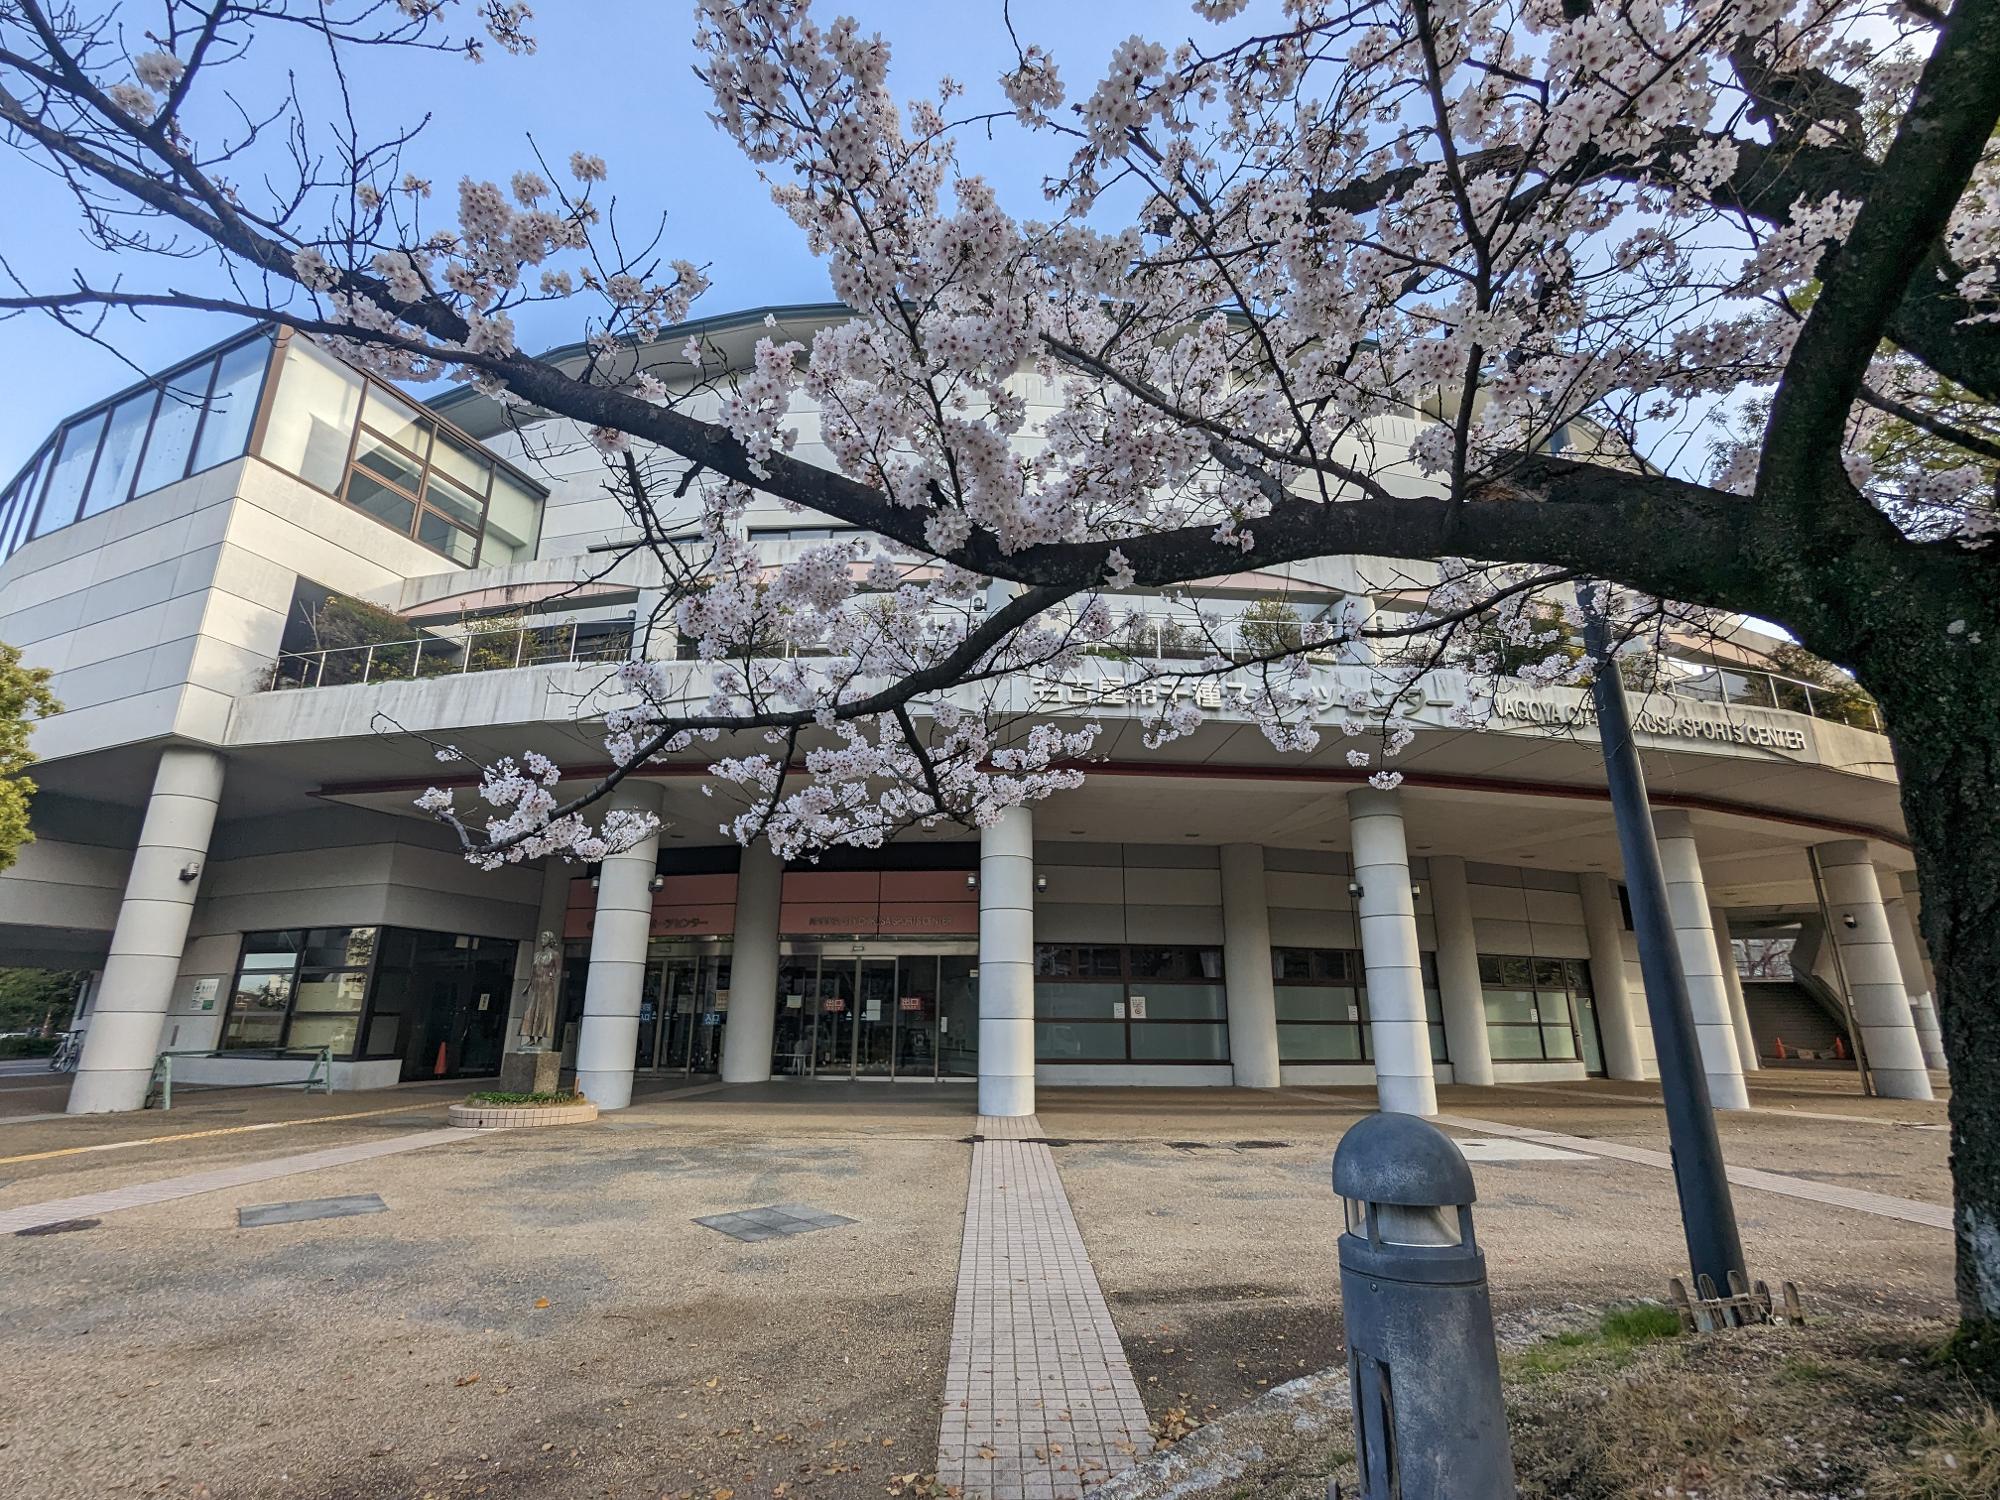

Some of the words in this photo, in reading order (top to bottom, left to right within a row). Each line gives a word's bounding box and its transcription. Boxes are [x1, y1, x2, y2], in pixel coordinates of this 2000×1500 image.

[1492, 694, 1562, 723] NAGOYA
[1681, 717, 1744, 743] SPORTS
[1747, 724, 1807, 749] CENTER
